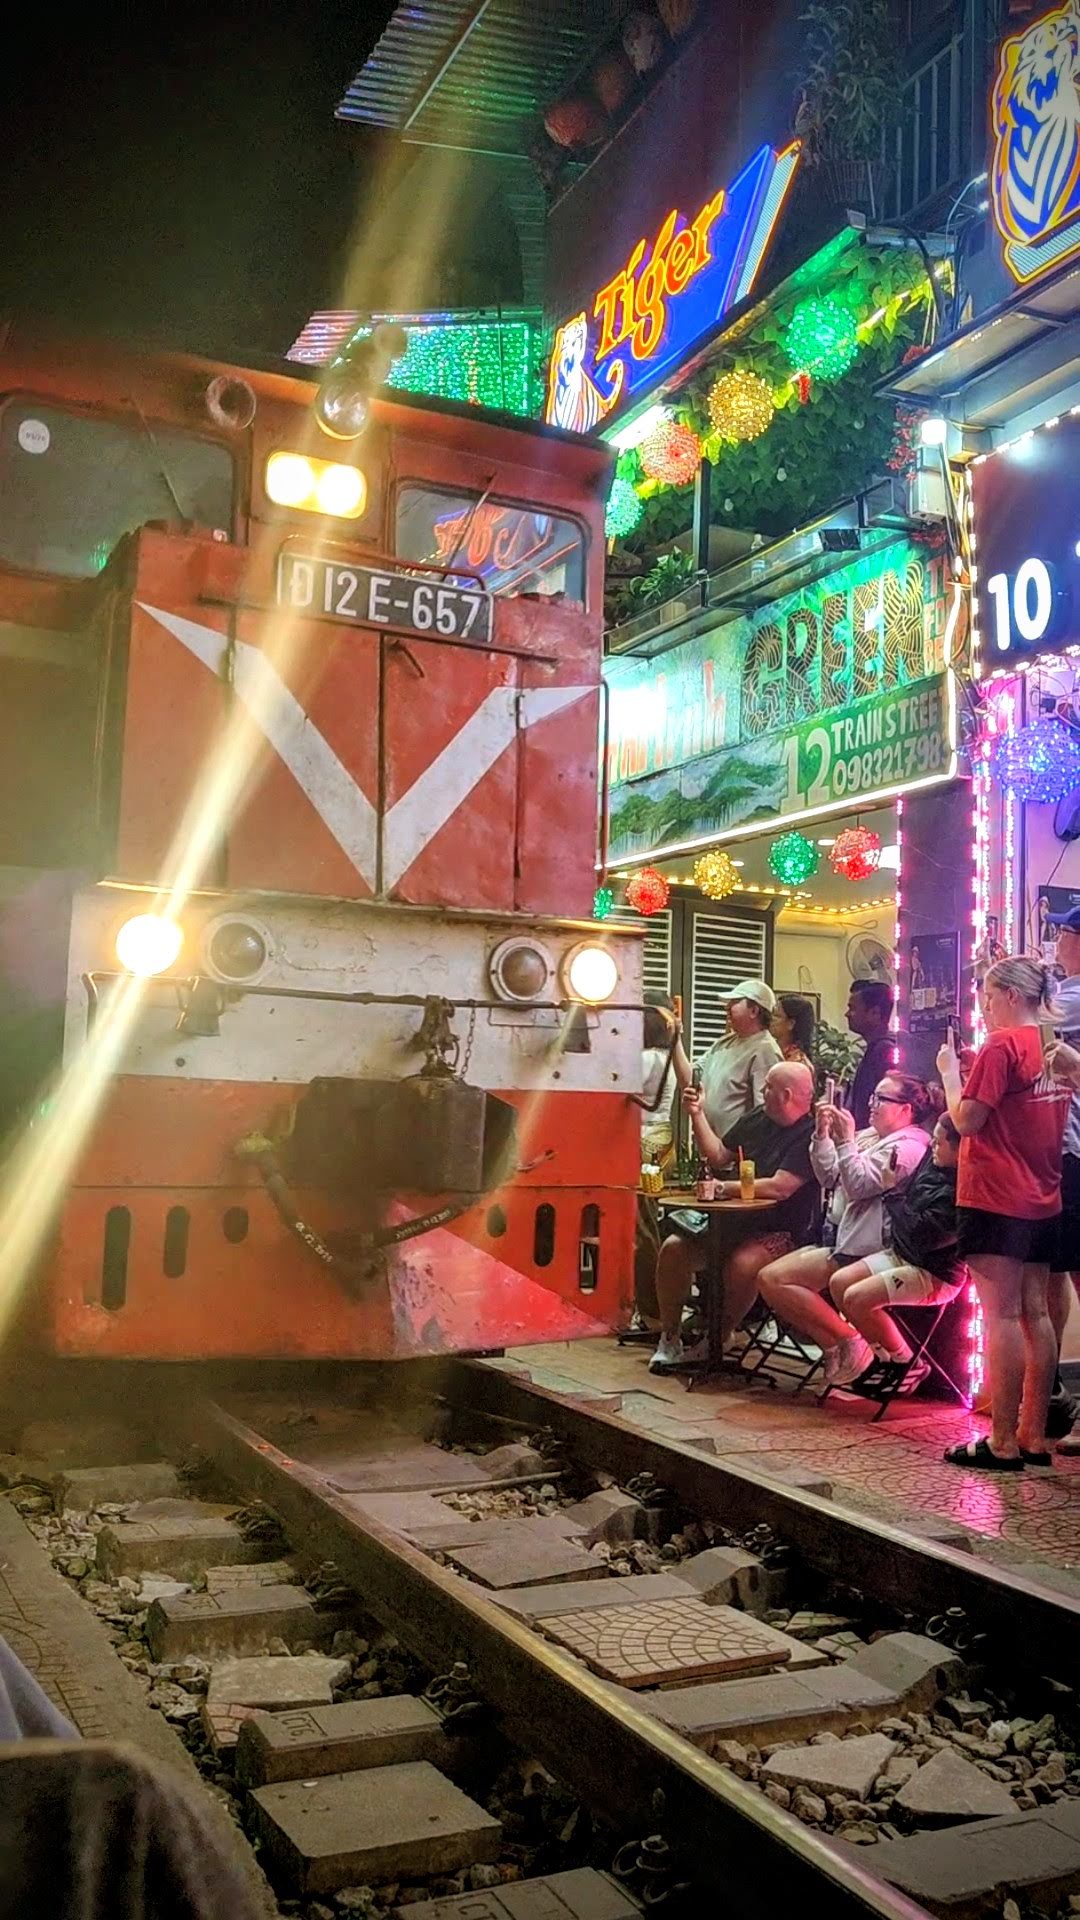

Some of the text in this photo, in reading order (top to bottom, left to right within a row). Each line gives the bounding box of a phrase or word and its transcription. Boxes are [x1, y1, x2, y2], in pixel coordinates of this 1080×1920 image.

[594, 190, 724, 361] Tiger
[743, 559, 924, 735] GREEN
[988, 558, 1052, 650] 10
[780, 727, 831, 814] 12
[831, 704, 883, 755] TRAIN
